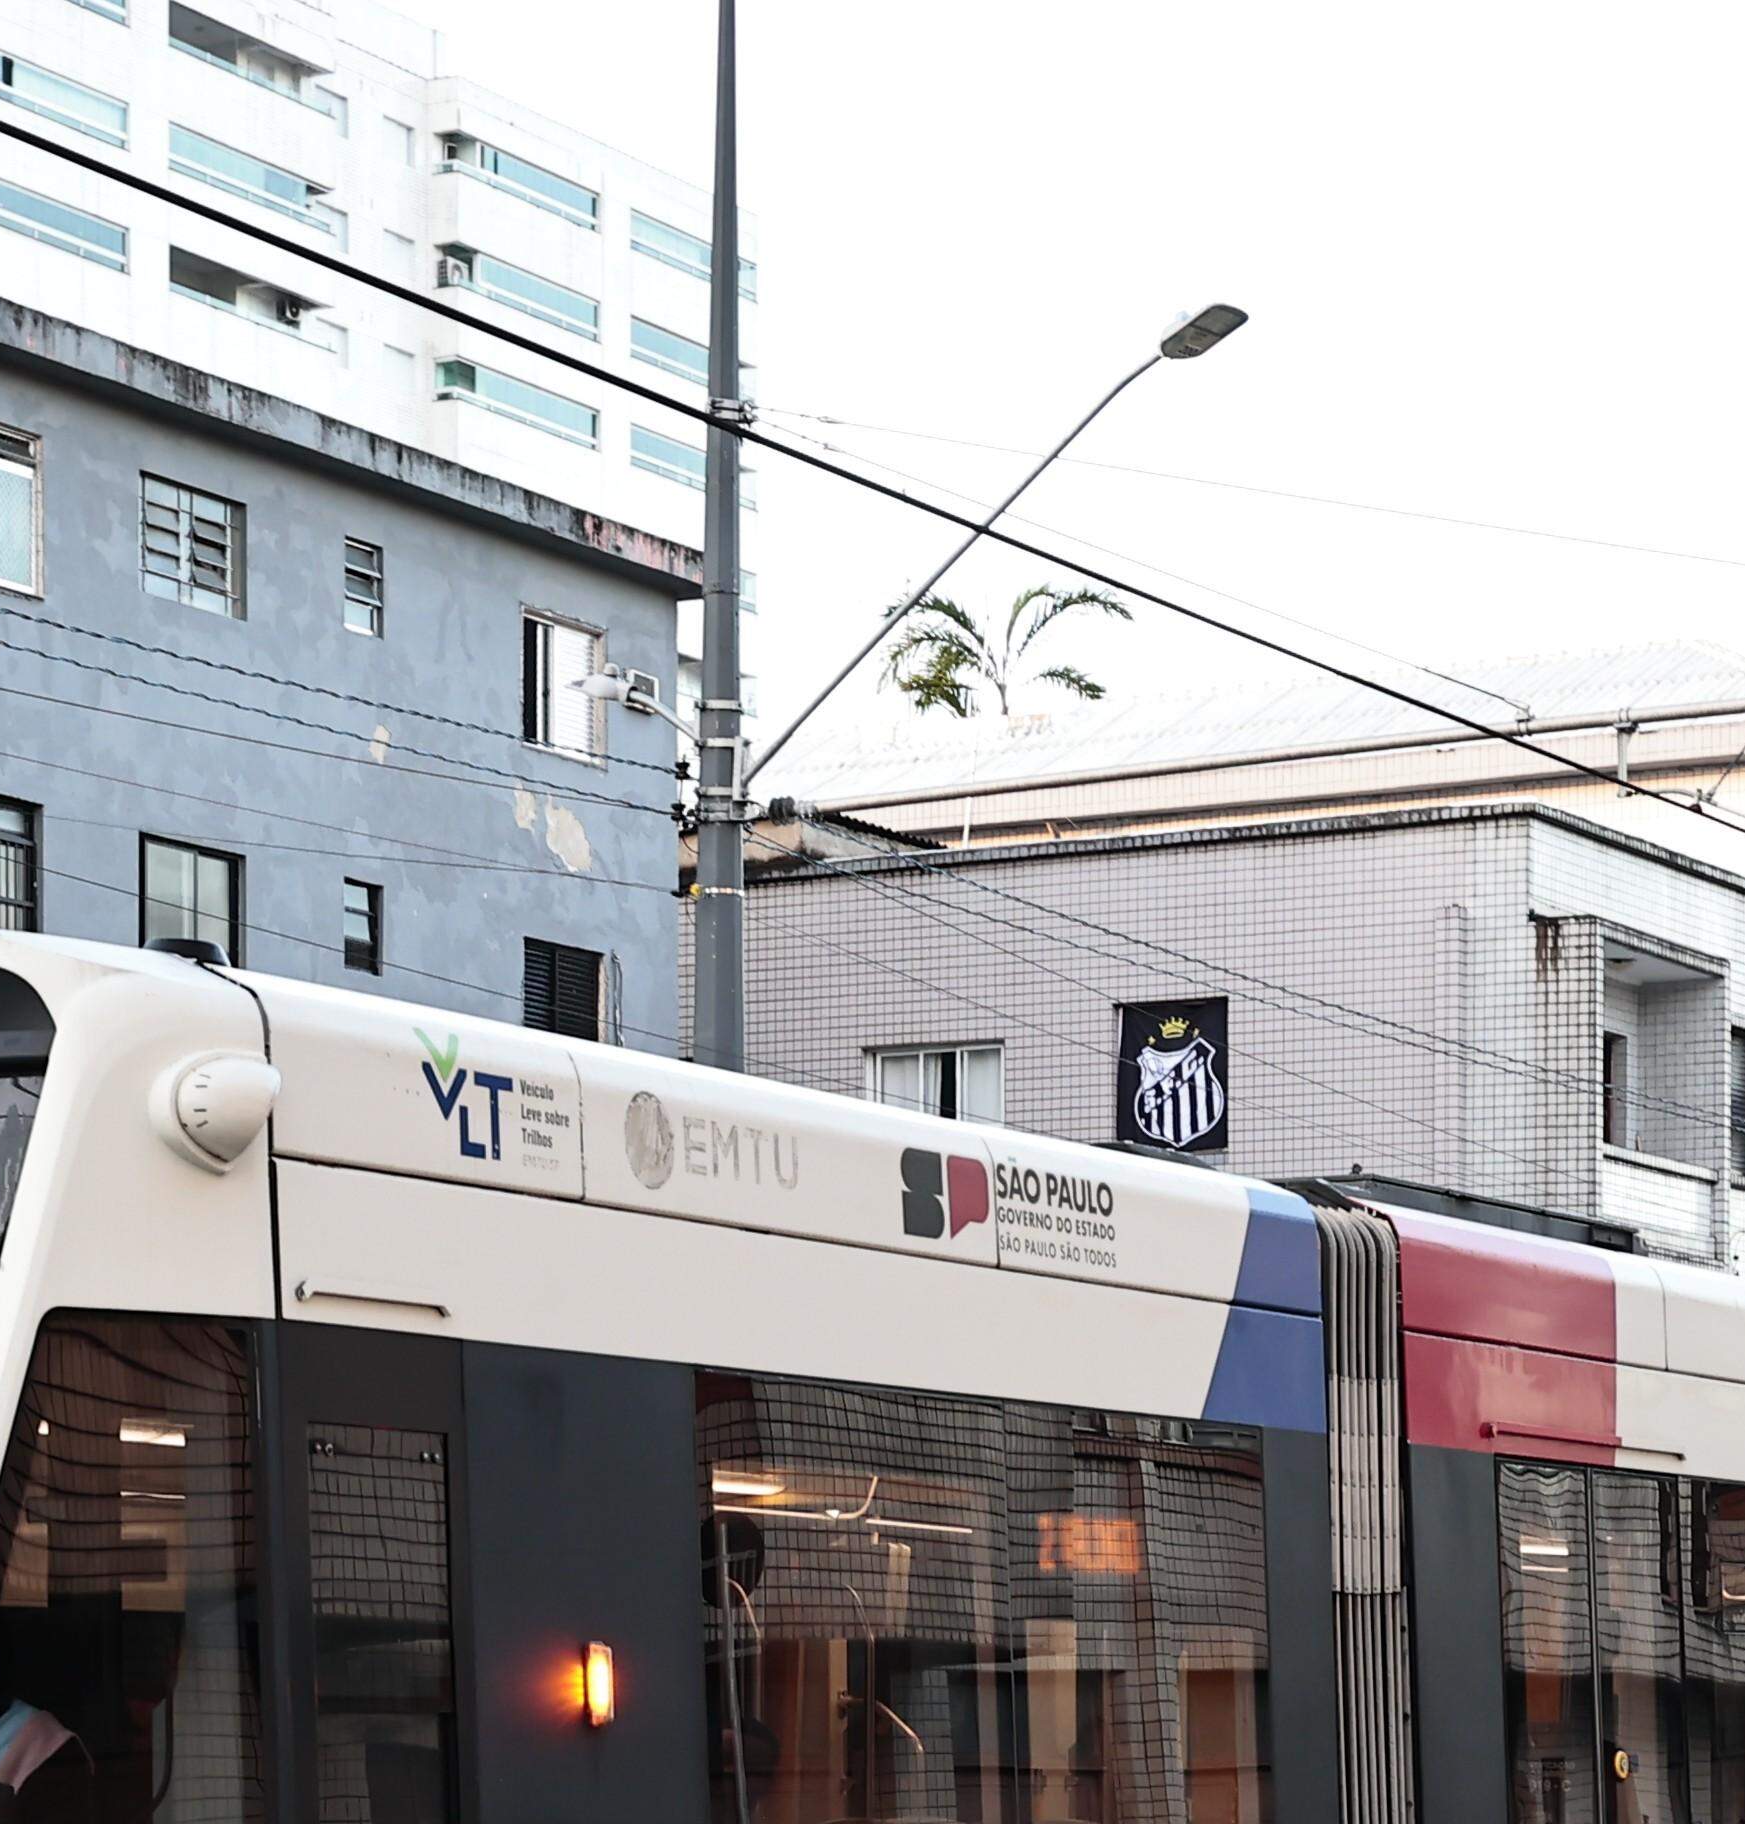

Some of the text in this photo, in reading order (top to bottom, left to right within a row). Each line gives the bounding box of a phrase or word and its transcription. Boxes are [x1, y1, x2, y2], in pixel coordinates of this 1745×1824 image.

[421, 1060, 513, 1161] VLT
[520, 1104, 570, 1128] Leve sobre
[521, 1127, 553, 1149] Trilhos
[683, 1116, 799, 1190] EMTU
[1046, 1172, 1114, 1217] PAULO
[997, 1206, 1116, 1241] GOVERNO DO ESTADO
[999, 1232, 1117, 1268] SÃO PAULO SÃO TODOS
